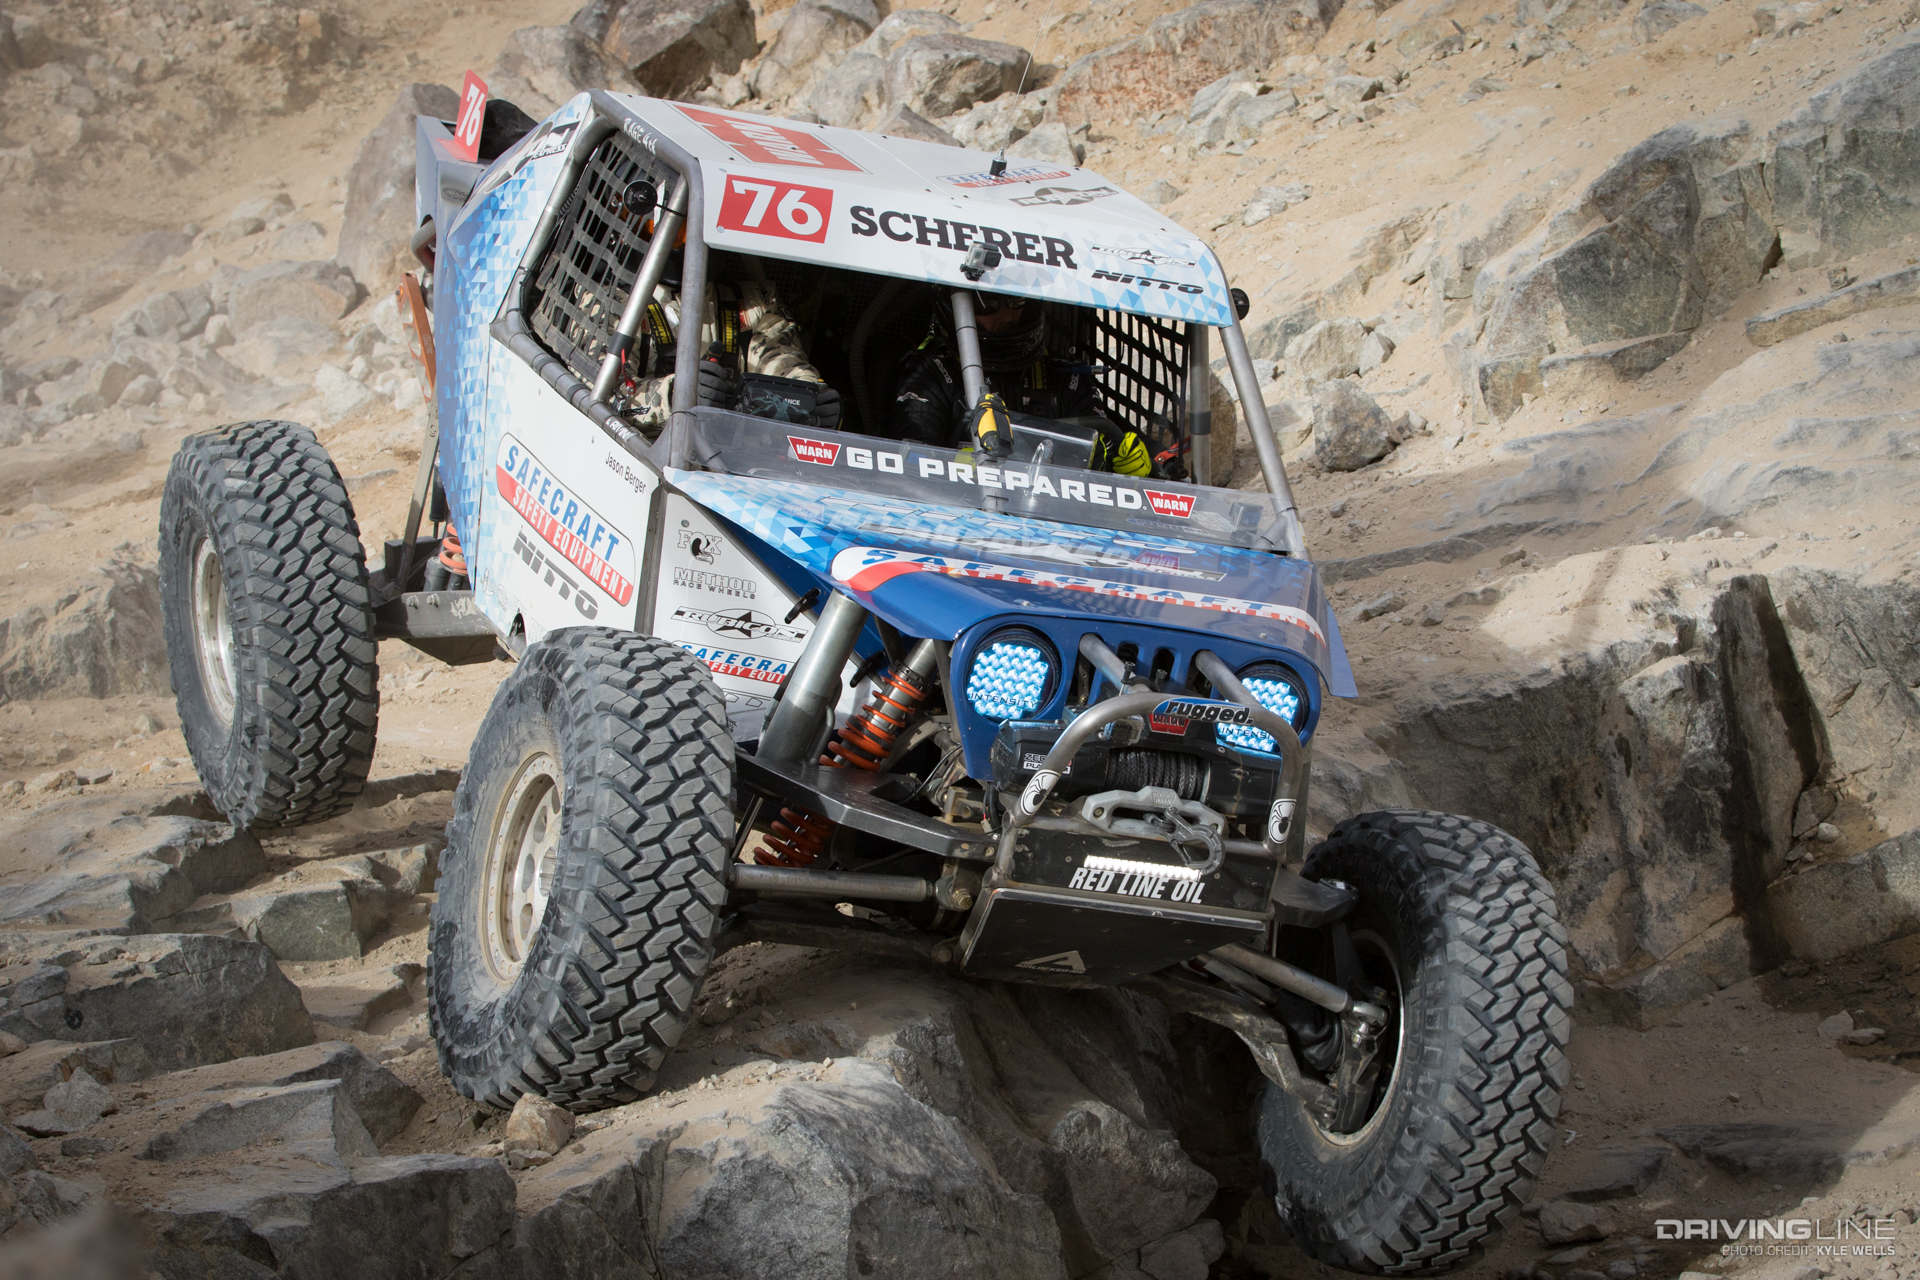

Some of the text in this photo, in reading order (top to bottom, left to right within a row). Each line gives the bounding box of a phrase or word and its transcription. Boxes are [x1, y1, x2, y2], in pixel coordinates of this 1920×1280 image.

[458, 83, 485, 146] 76
[731, 180, 1078, 269] 76 SCHERER
[1091, 269, 1204, 294] NITTO
[605, 450, 647, 496] Jason Berger
[847, 446, 902, 475] GO
[505, 444, 620, 563] SAFECRAFT
[512, 484, 551, 538] SAFETY
[551, 523, 630, 602] EQUIPMENT
[677, 529, 723, 565] FOX
[512, 530, 598, 620] NITTO
[673, 579, 756, 600] RACE WHEELS
[674, 567, 757, 593] METHOD
[862, 549, 1274, 611] SAFECRAFT
[922, 563, 1324, 636] SAFETY EQUIPMENT
[679, 610, 800, 639] RUBICON
[681, 644, 788, 675] SAFECRA
[704, 660, 746, 677] AFETY
[970, 692, 1038, 708] INTENSITY
[1221, 726, 1274, 741] INTENSI
[1068, 867, 1205, 904] RED LINE OIL
